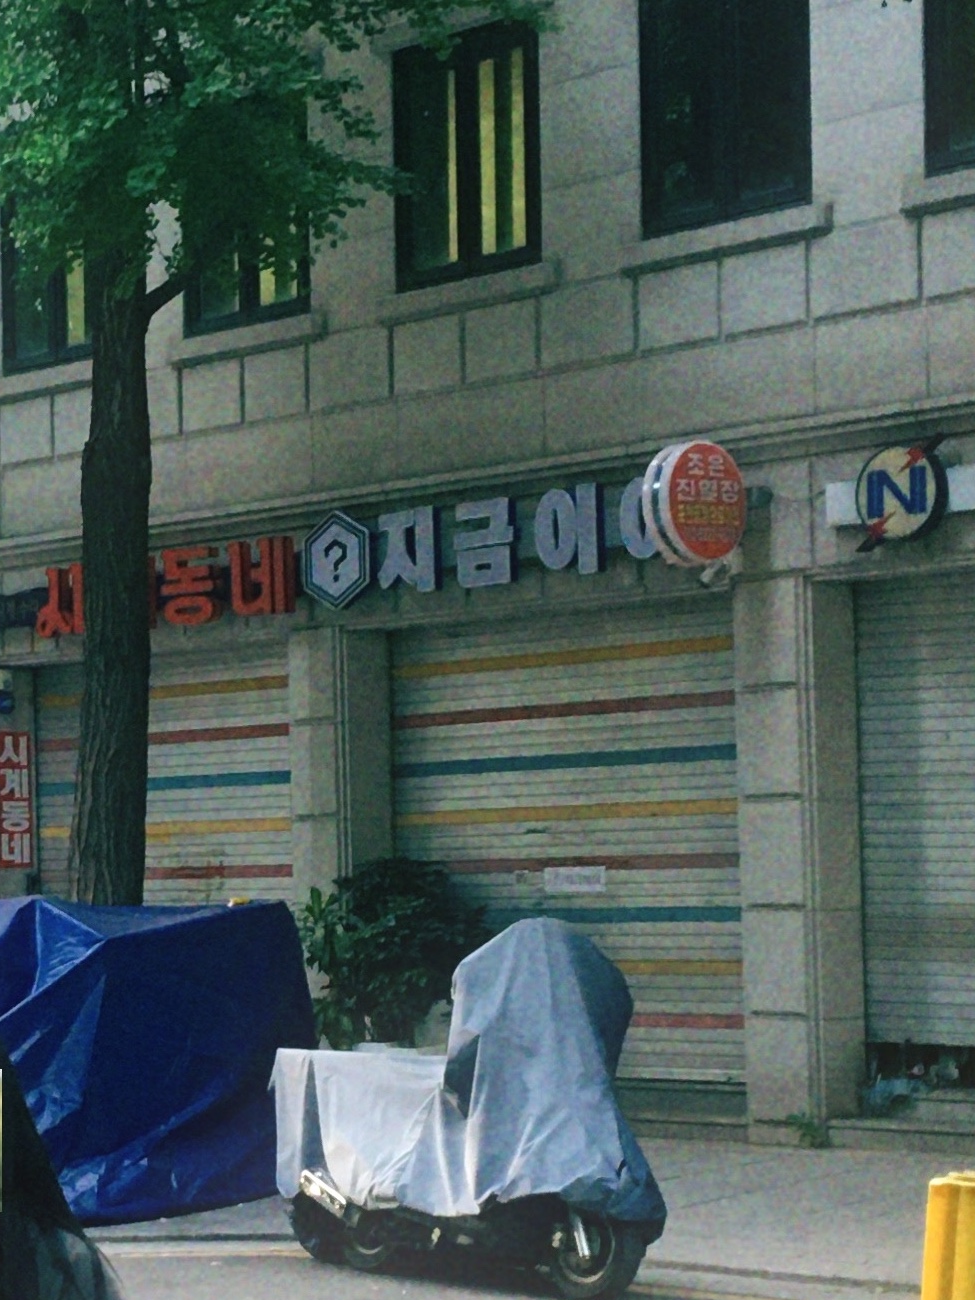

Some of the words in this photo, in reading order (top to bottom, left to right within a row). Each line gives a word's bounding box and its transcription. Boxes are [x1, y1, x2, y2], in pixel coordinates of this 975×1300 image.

[688, 453, 725, 477] 조은
[866, 465, 927, 520] N
[36, 536, 296, 638] 시동네
[0, 735, 31, 864] 시계동네
